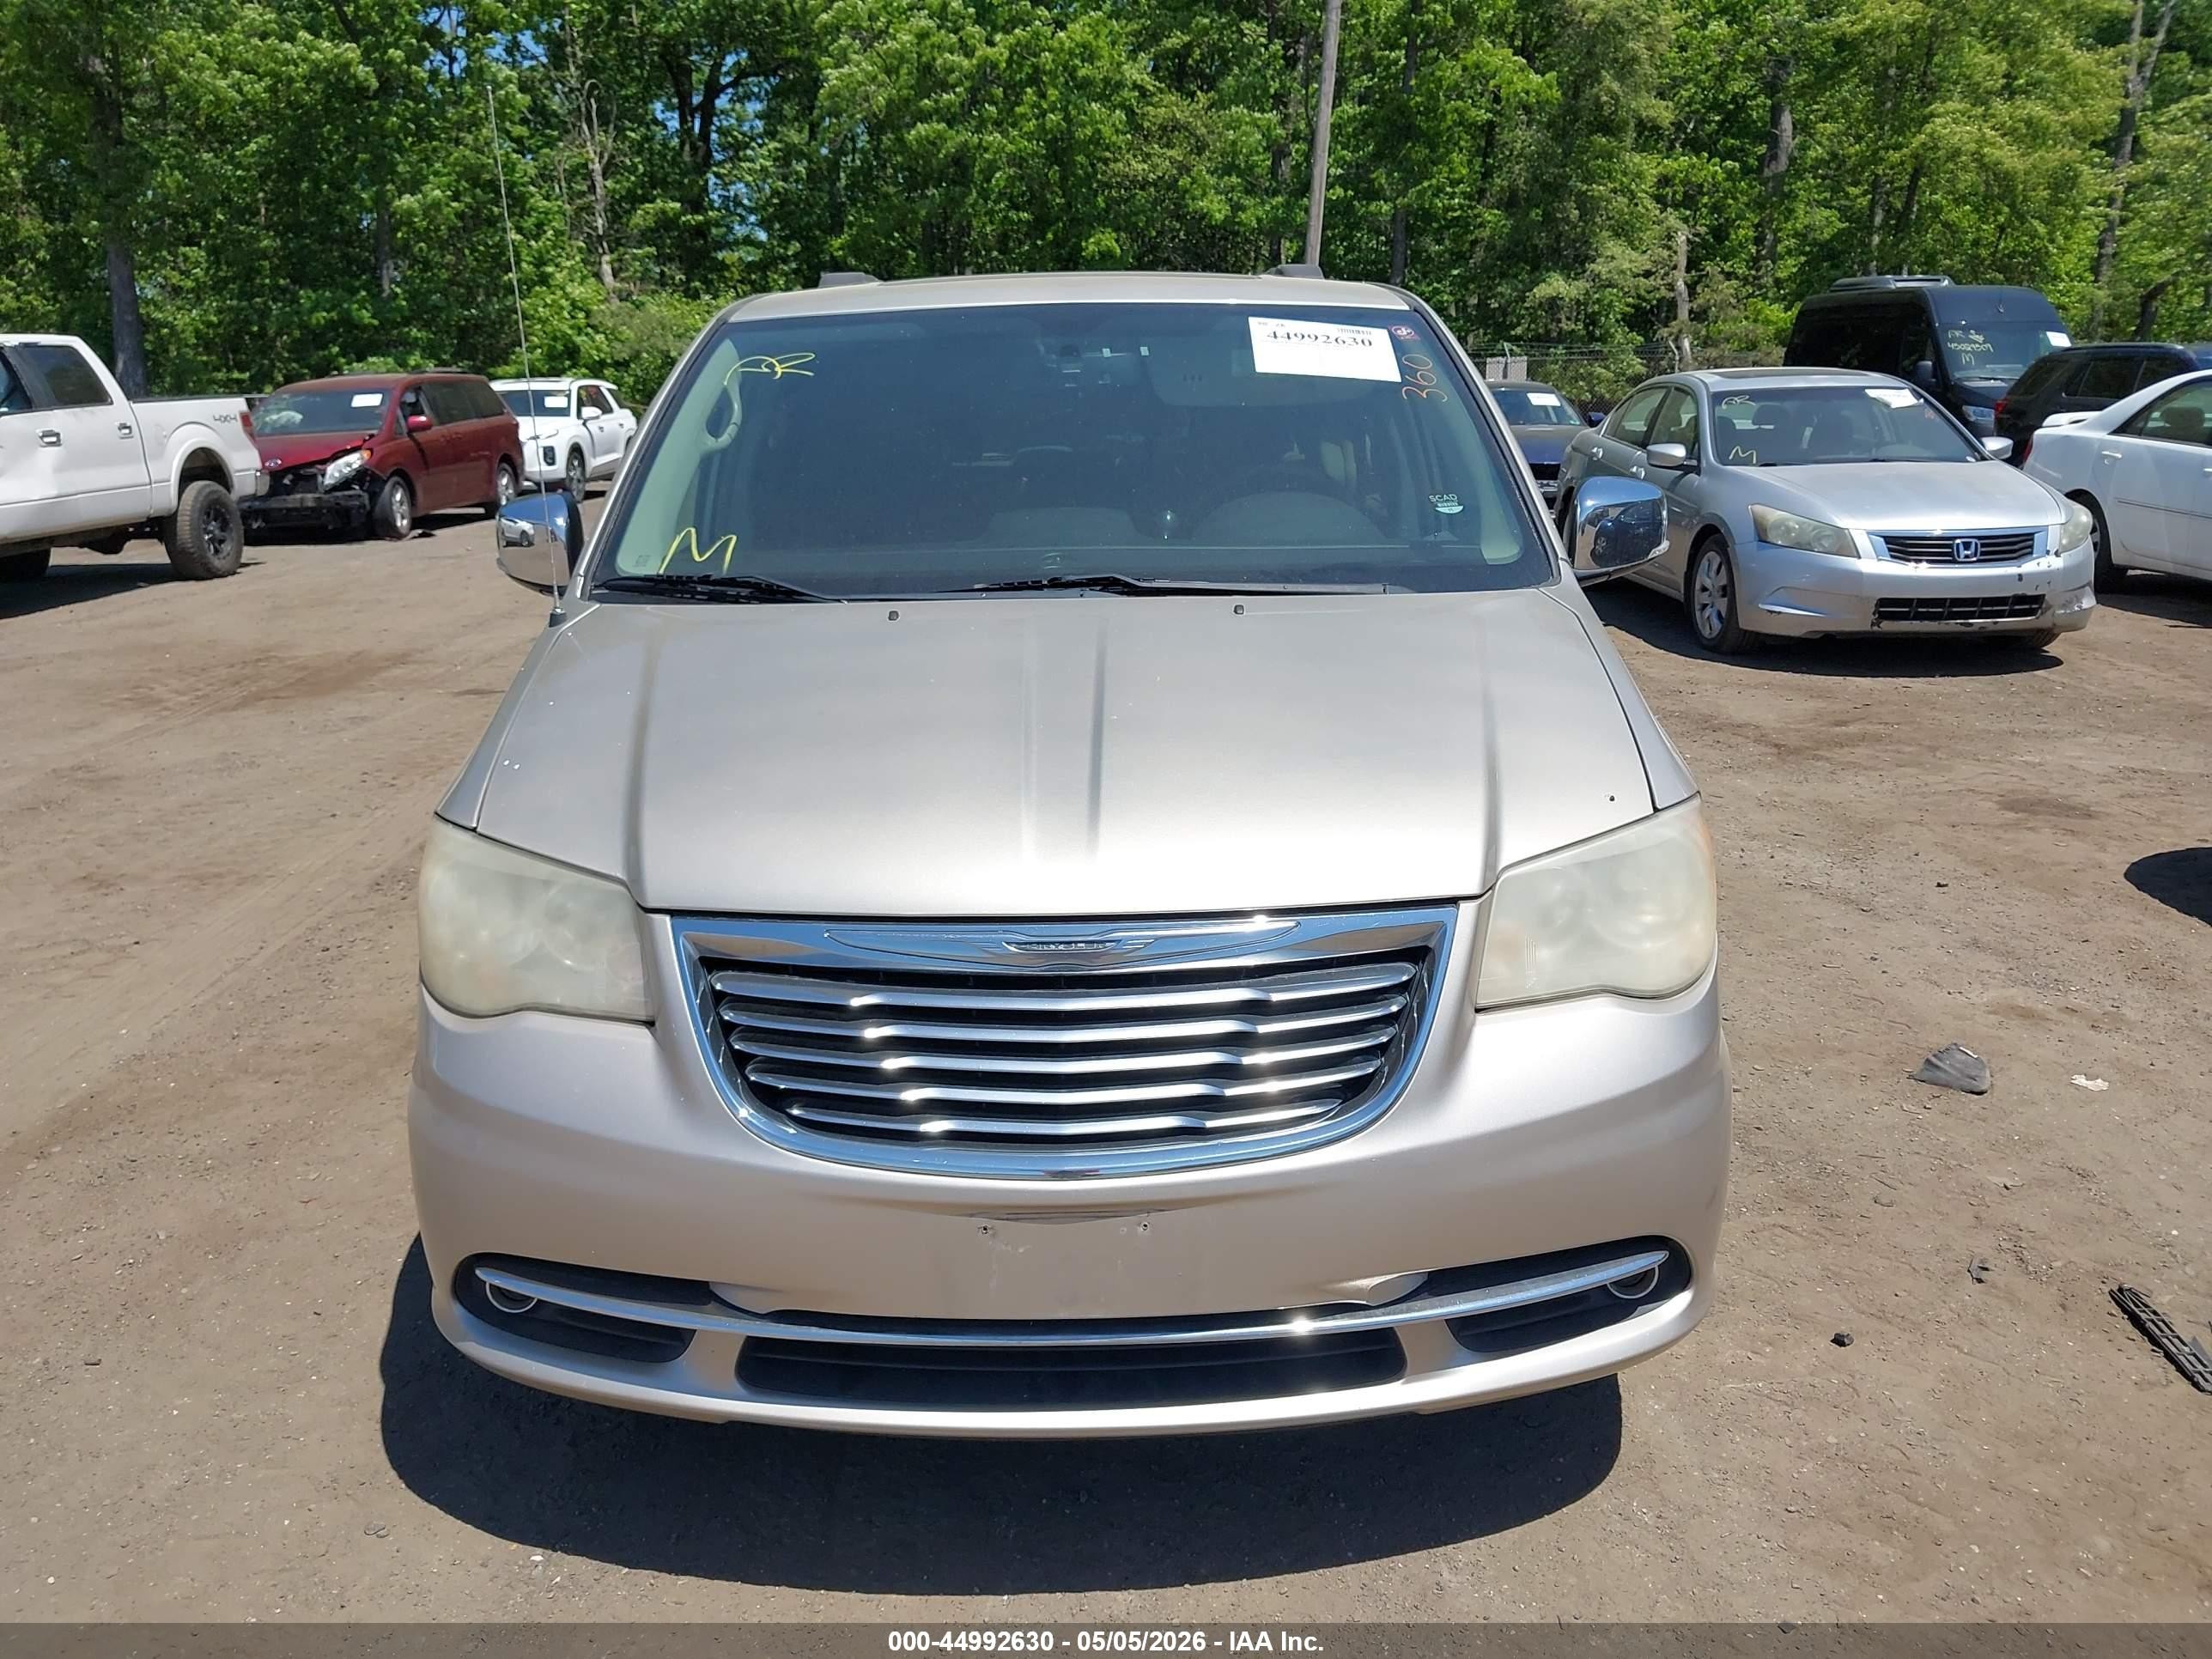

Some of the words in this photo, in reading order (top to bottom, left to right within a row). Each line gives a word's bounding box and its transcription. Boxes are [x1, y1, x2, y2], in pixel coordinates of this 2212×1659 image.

[1266, 330, 1373, 347] 44992630
[1401, 354, 1448, 402] 360
[1729, 446, 1757, 464] M
[1428, 494, 1458, 502] SCAD
[658, 527, 737, 575] M
